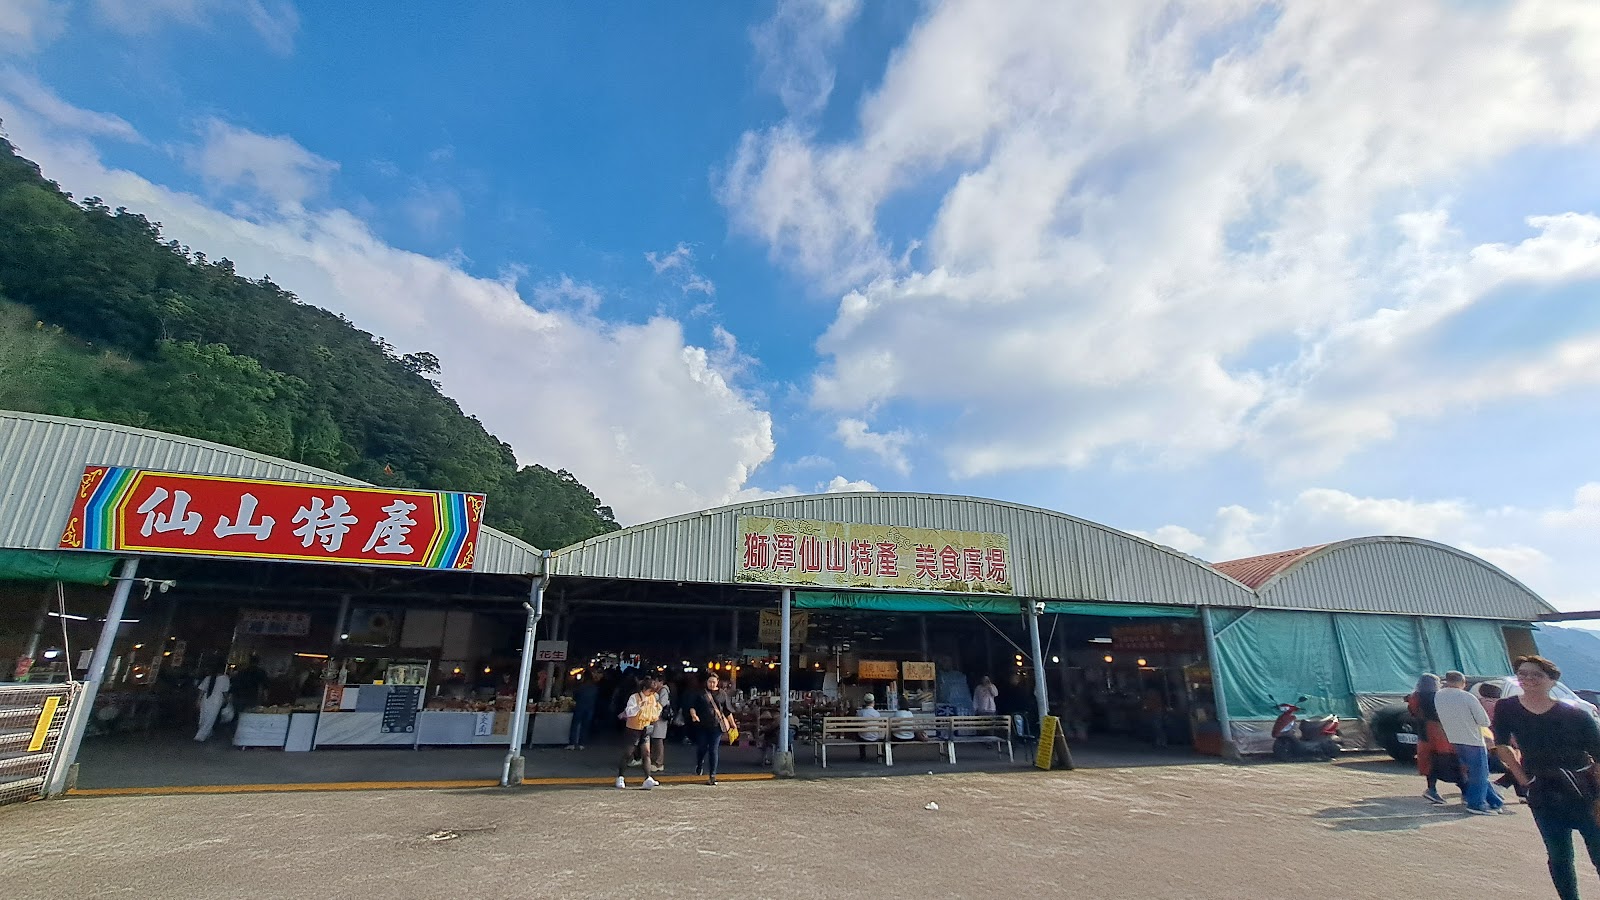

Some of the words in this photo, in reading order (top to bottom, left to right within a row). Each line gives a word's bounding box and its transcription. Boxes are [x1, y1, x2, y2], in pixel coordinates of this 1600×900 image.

[136, 486, 418, 556] 仙山特產
[743, 532, 899, 577] 獅潭仙山特產
[914, 543, 1008, 584] 美食廣場
[539, 650, 565, 659] 花生
